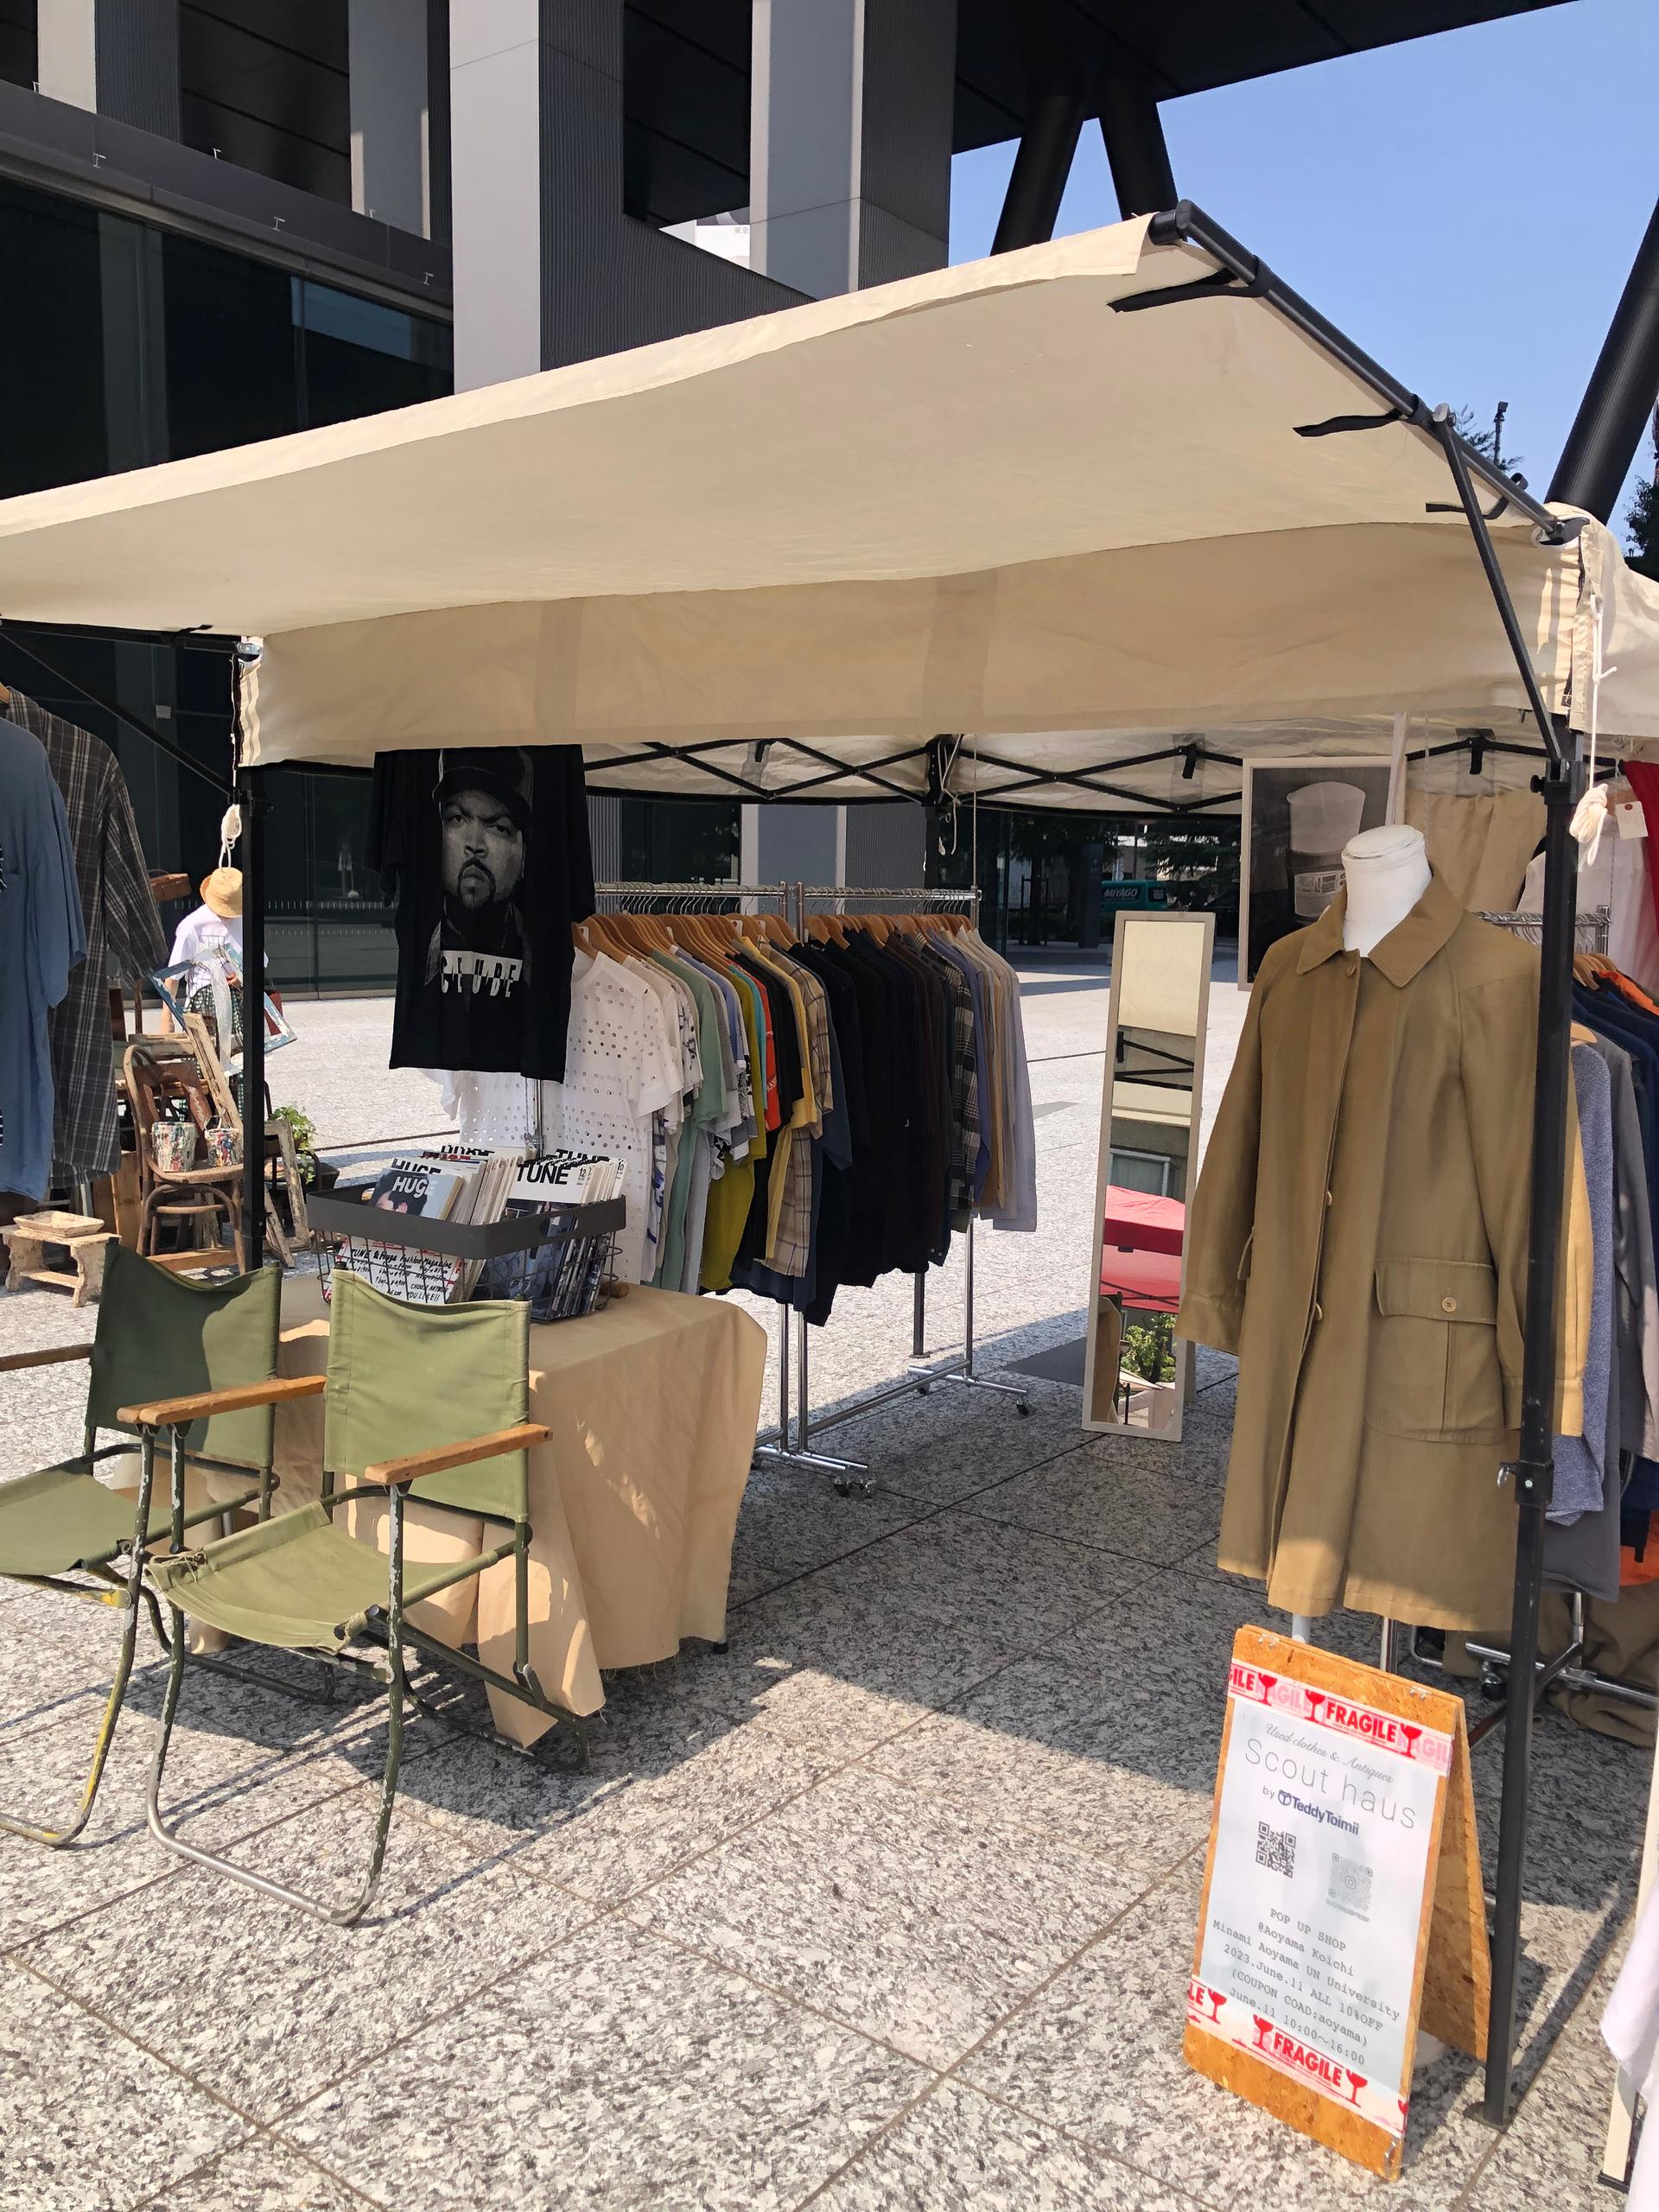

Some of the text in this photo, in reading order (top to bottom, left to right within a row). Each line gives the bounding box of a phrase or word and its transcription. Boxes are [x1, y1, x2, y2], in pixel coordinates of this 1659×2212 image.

[517, 1161, 570, 1185] TUNE
[1325, 1700, 1397, 1744] FRAGILE
[1266, 1723, 1394, 1783] Used clothes & Antiques
[1245, 1738, 1416, 1829] Scout haus
[1262, 1785, 1275, 1800] by
[1291, 1795, 1360, 1835] TeddyToimii
[1258, 1921, 1354, 1977] @Aoyama Koichi
[1269, 1908, 1347, 1951] POP UP SHOP
[1212, 1919, 1400, 2021] Minami Aoyama UN University
[1231, 1968, 1278, 1999] (COUPON
[1310, 1990, 1332, 2007] ALL
[1339, 2003, 1383, 2031] 10%OFF
[1273, 2033, 1342, 2088] FRAGILE
